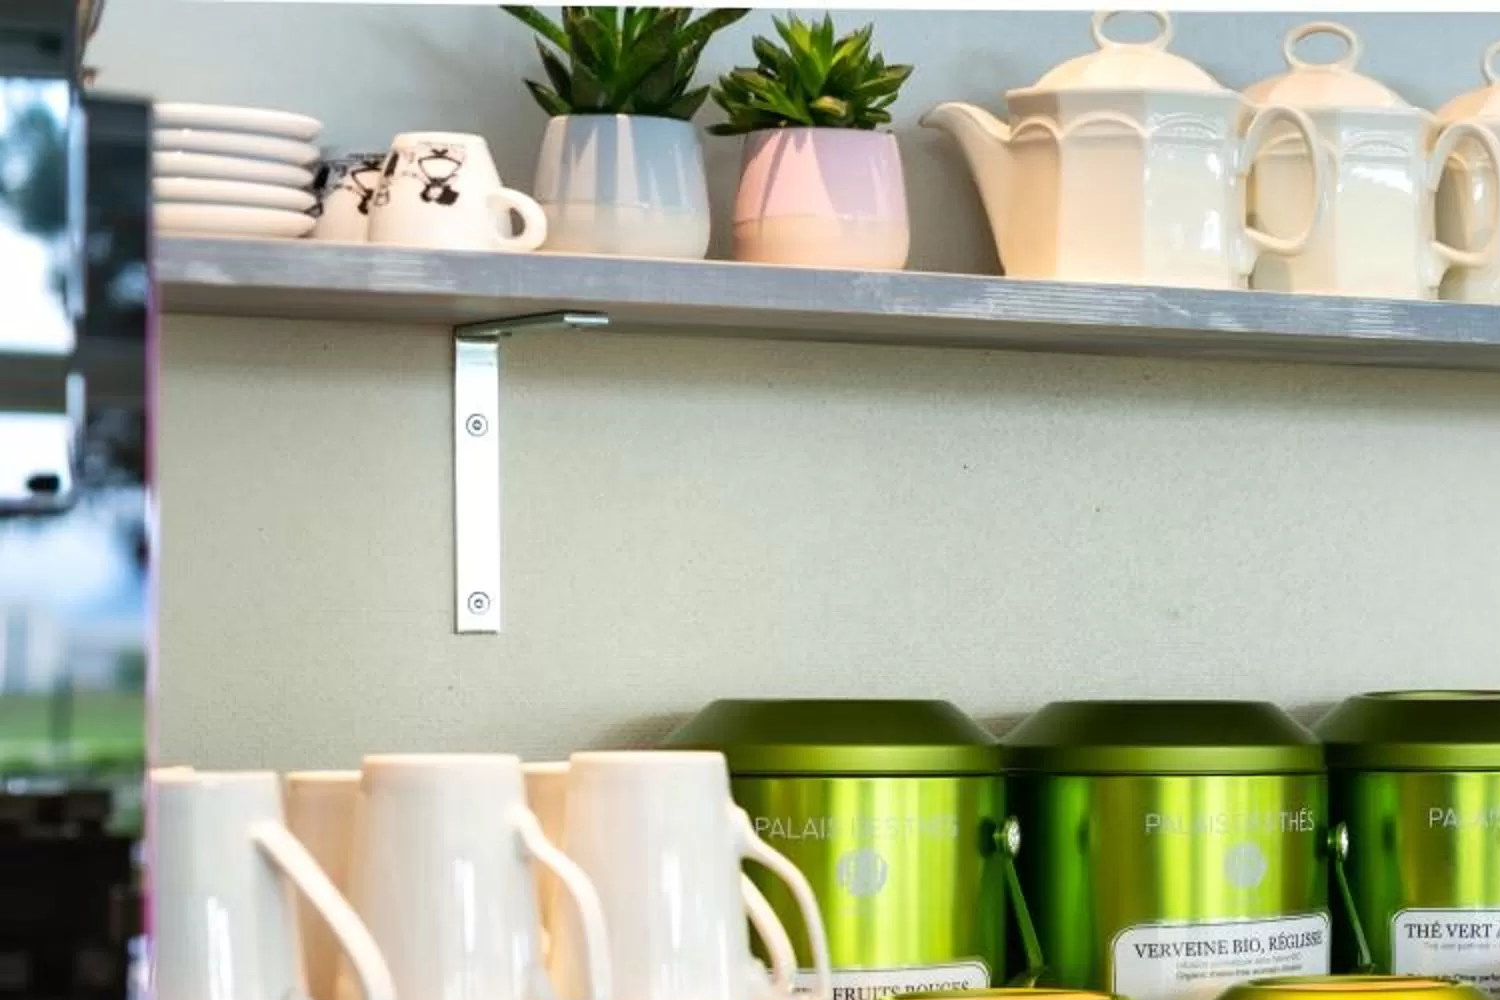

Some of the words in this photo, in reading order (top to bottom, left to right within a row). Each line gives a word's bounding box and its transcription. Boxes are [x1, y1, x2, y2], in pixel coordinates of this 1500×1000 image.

[1279, 807, 1316, 833] THÉS
[1404, 920, 1442, 938] THÉ
[1446, 923, 1492, 938] VERT
[1133, 939, 1230, 959] VERVEINE
[1233, 936, 1265, 955] BIO,
[1268, 930, 1324, 951] RÉGLISSE
